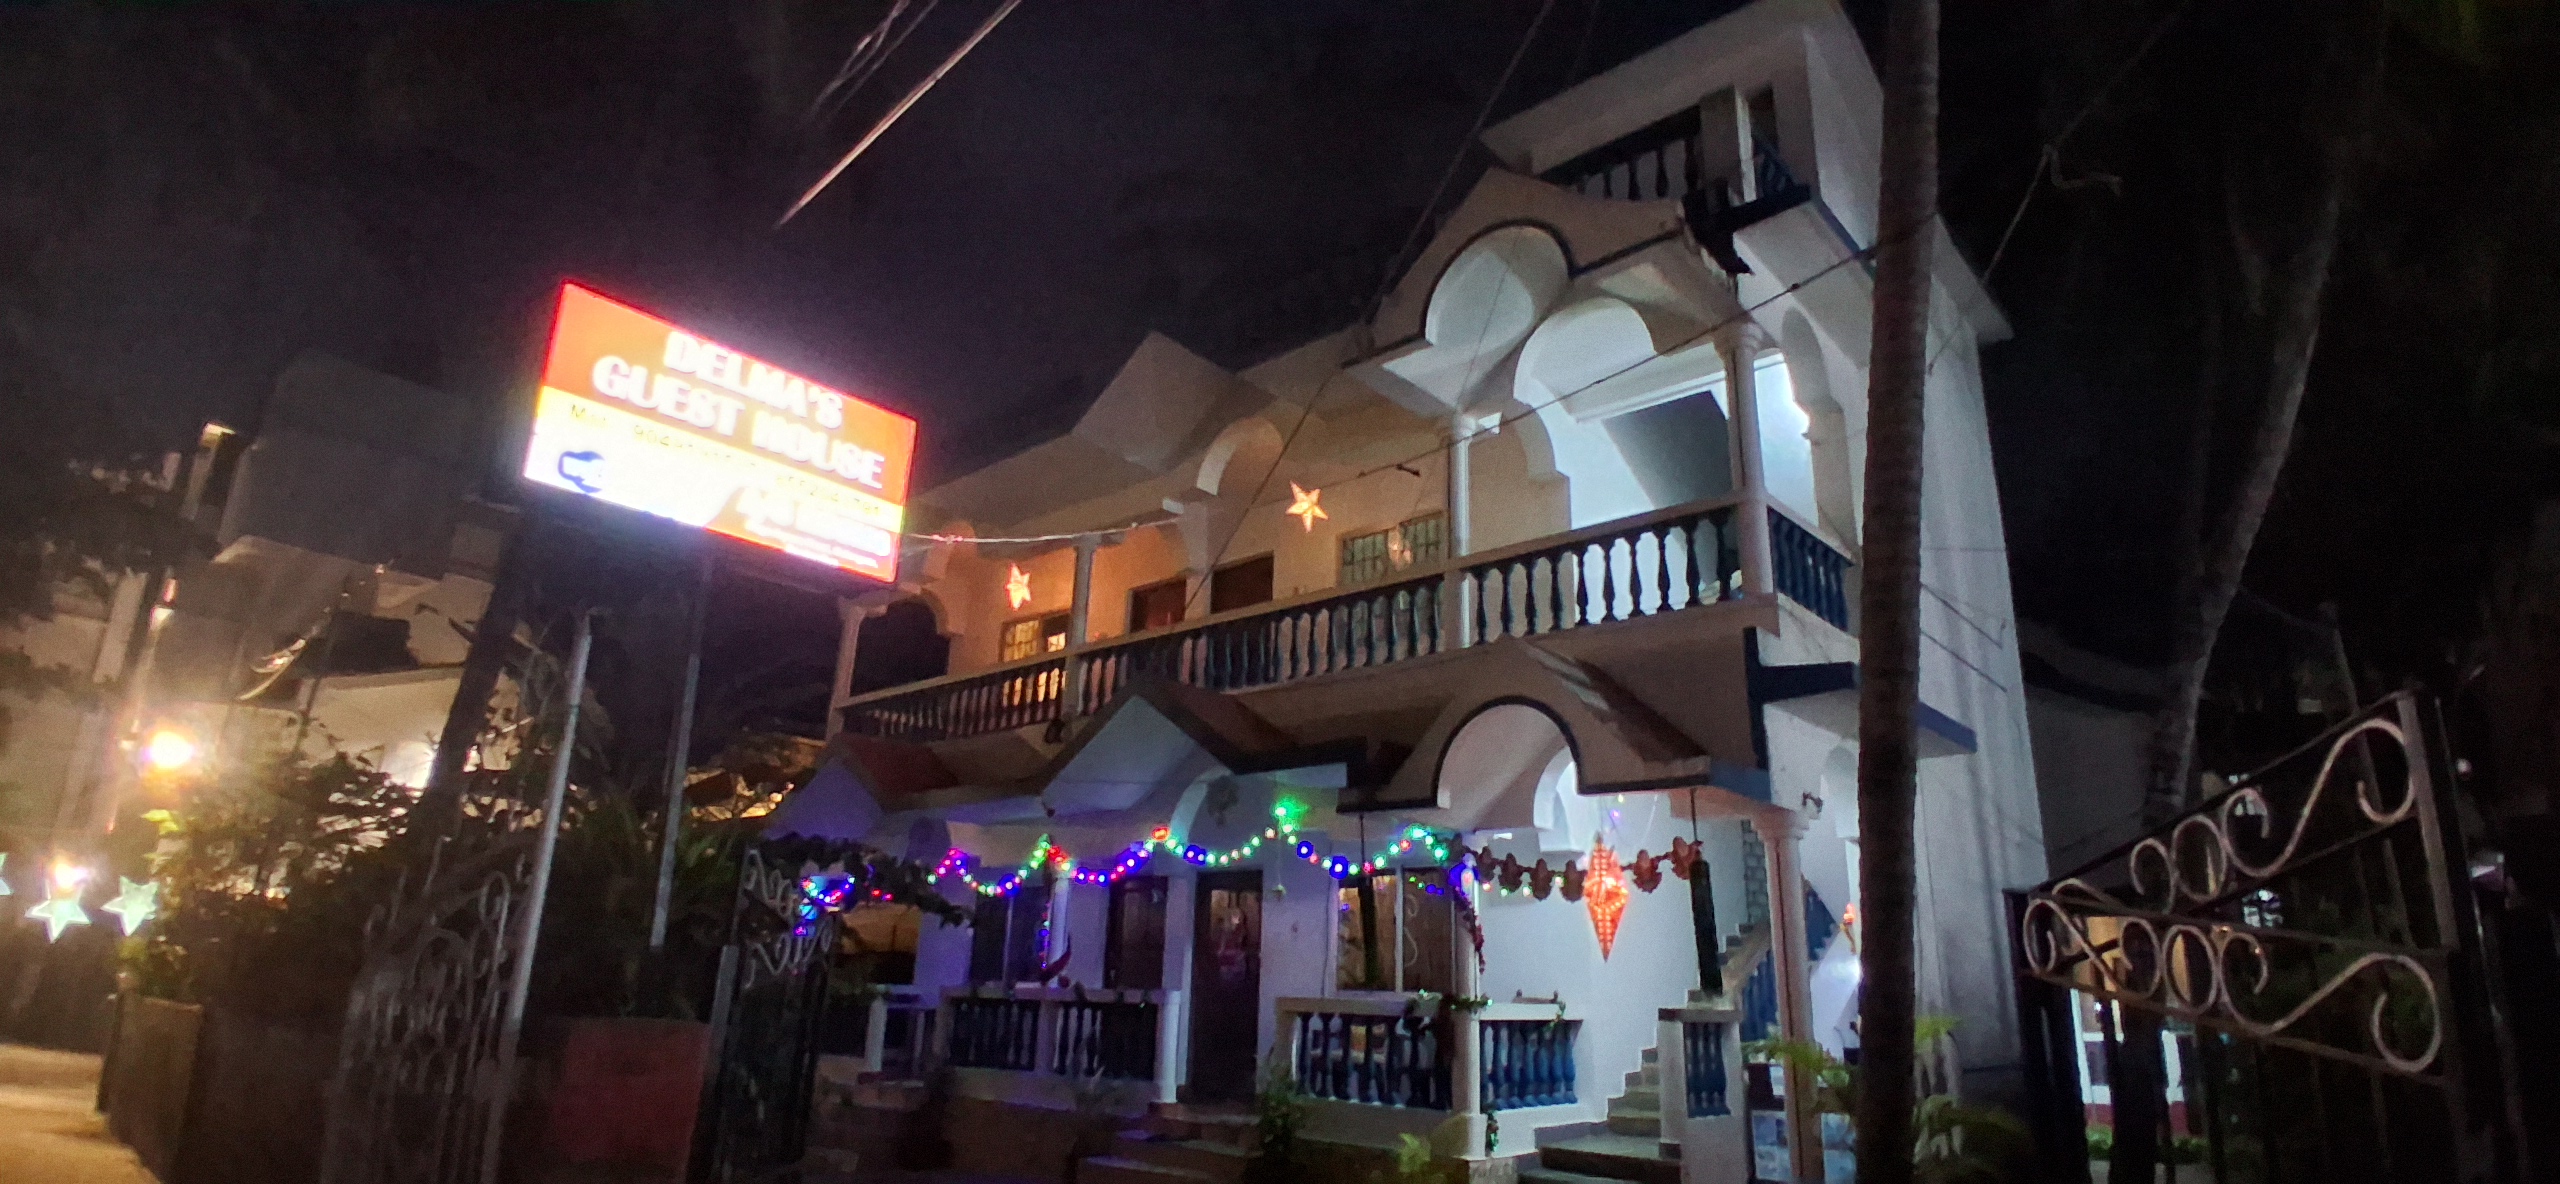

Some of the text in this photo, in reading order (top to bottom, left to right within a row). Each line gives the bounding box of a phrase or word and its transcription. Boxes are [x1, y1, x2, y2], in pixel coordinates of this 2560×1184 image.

[592, 355, 746, 437] GUEST
[751, 409, 885, 490] HOUSE
[665, 331, 843, 429] DELMA'S
